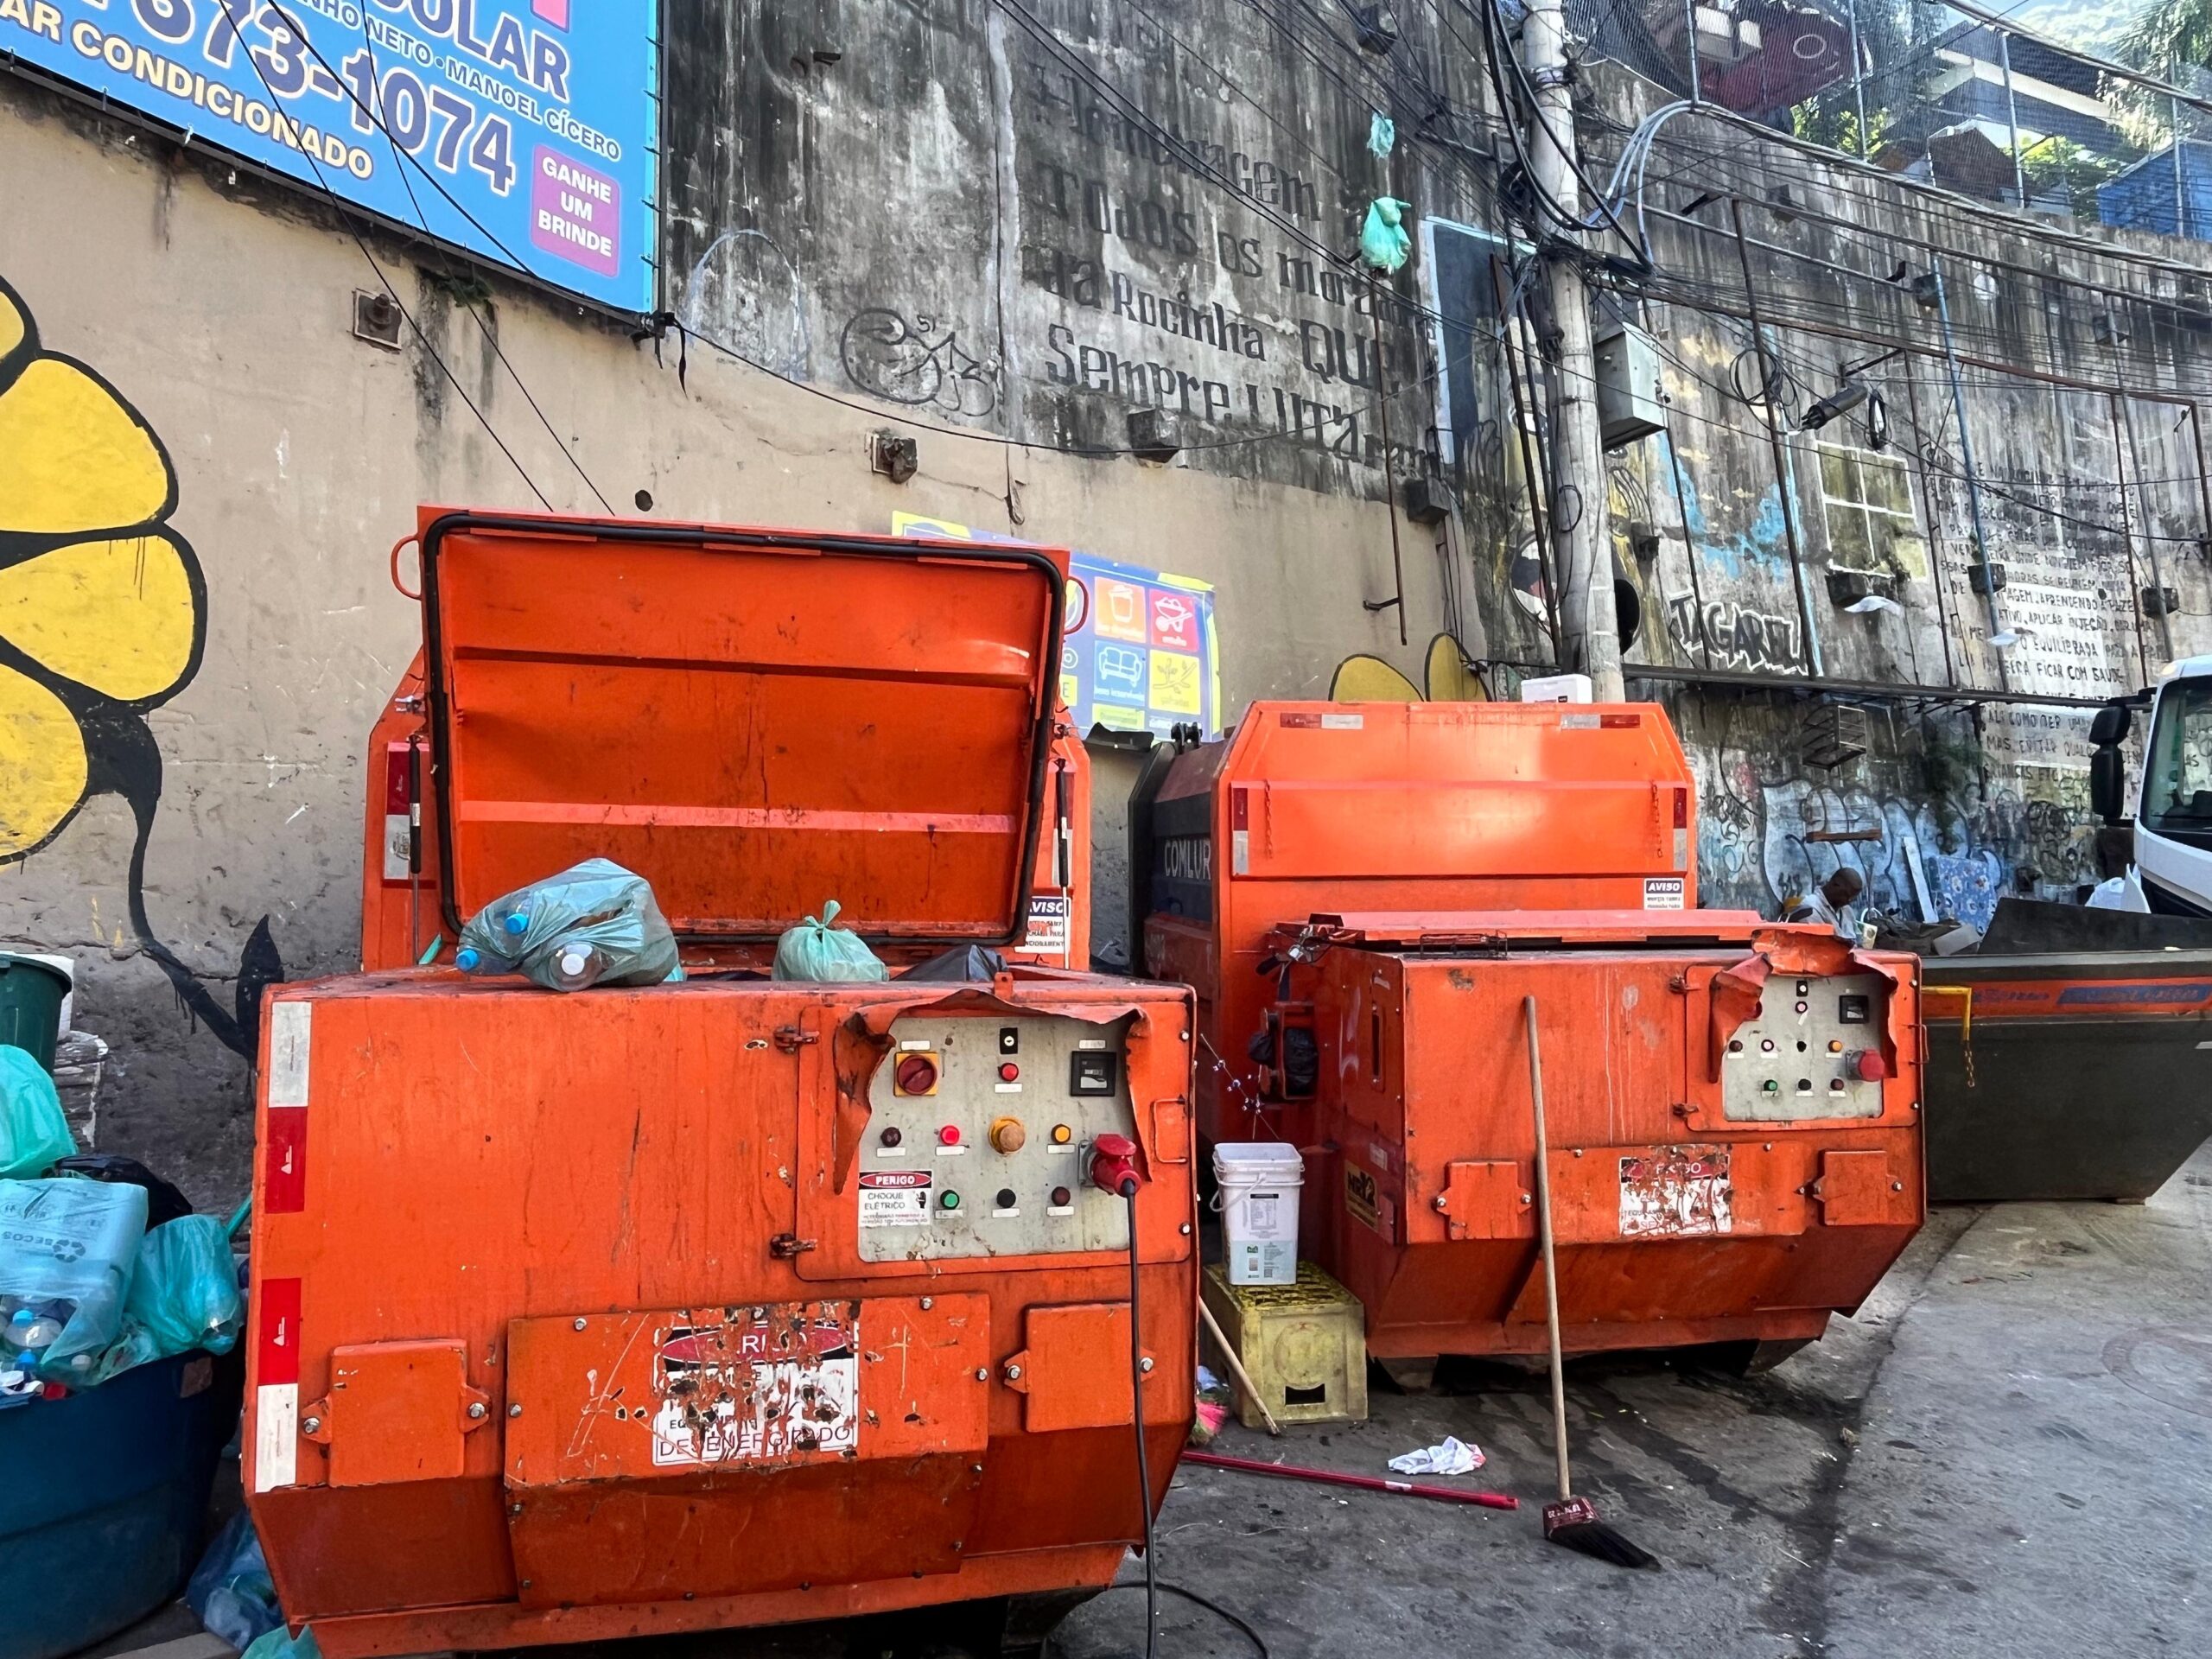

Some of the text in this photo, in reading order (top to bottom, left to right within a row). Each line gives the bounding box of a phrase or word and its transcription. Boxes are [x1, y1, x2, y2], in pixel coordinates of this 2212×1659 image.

[0, 0, 373, 180] AR CONDICIONADO
[85, 0, 516, 196] 73-1074
[367, 13, 432, 67] NETO
[446, 56, 543, 124] MANOEL
[544, 108, 621, 162] CÍCERO
[543, 156, 612, 204] GANHE
[560, 190, 593, 222] UM
[537, 209, 613, 257] BRINDE
[1109, 270, 1268, 361] Rocinha
[1045, 323, 1233, 424] Sempre
[2037, 663, 2064, 678] FICAR
[2067, 665, 2088, 680] COM
[1165, 838, 1211, 880] COMLUR
[1029, 901, 1064, 913] VISO
[1647, 882, 1681, 892] AVISO
[875, 1175, 915, 1185] PERIGO
[864, 1201, 906, 1211] ELÉTRICO
